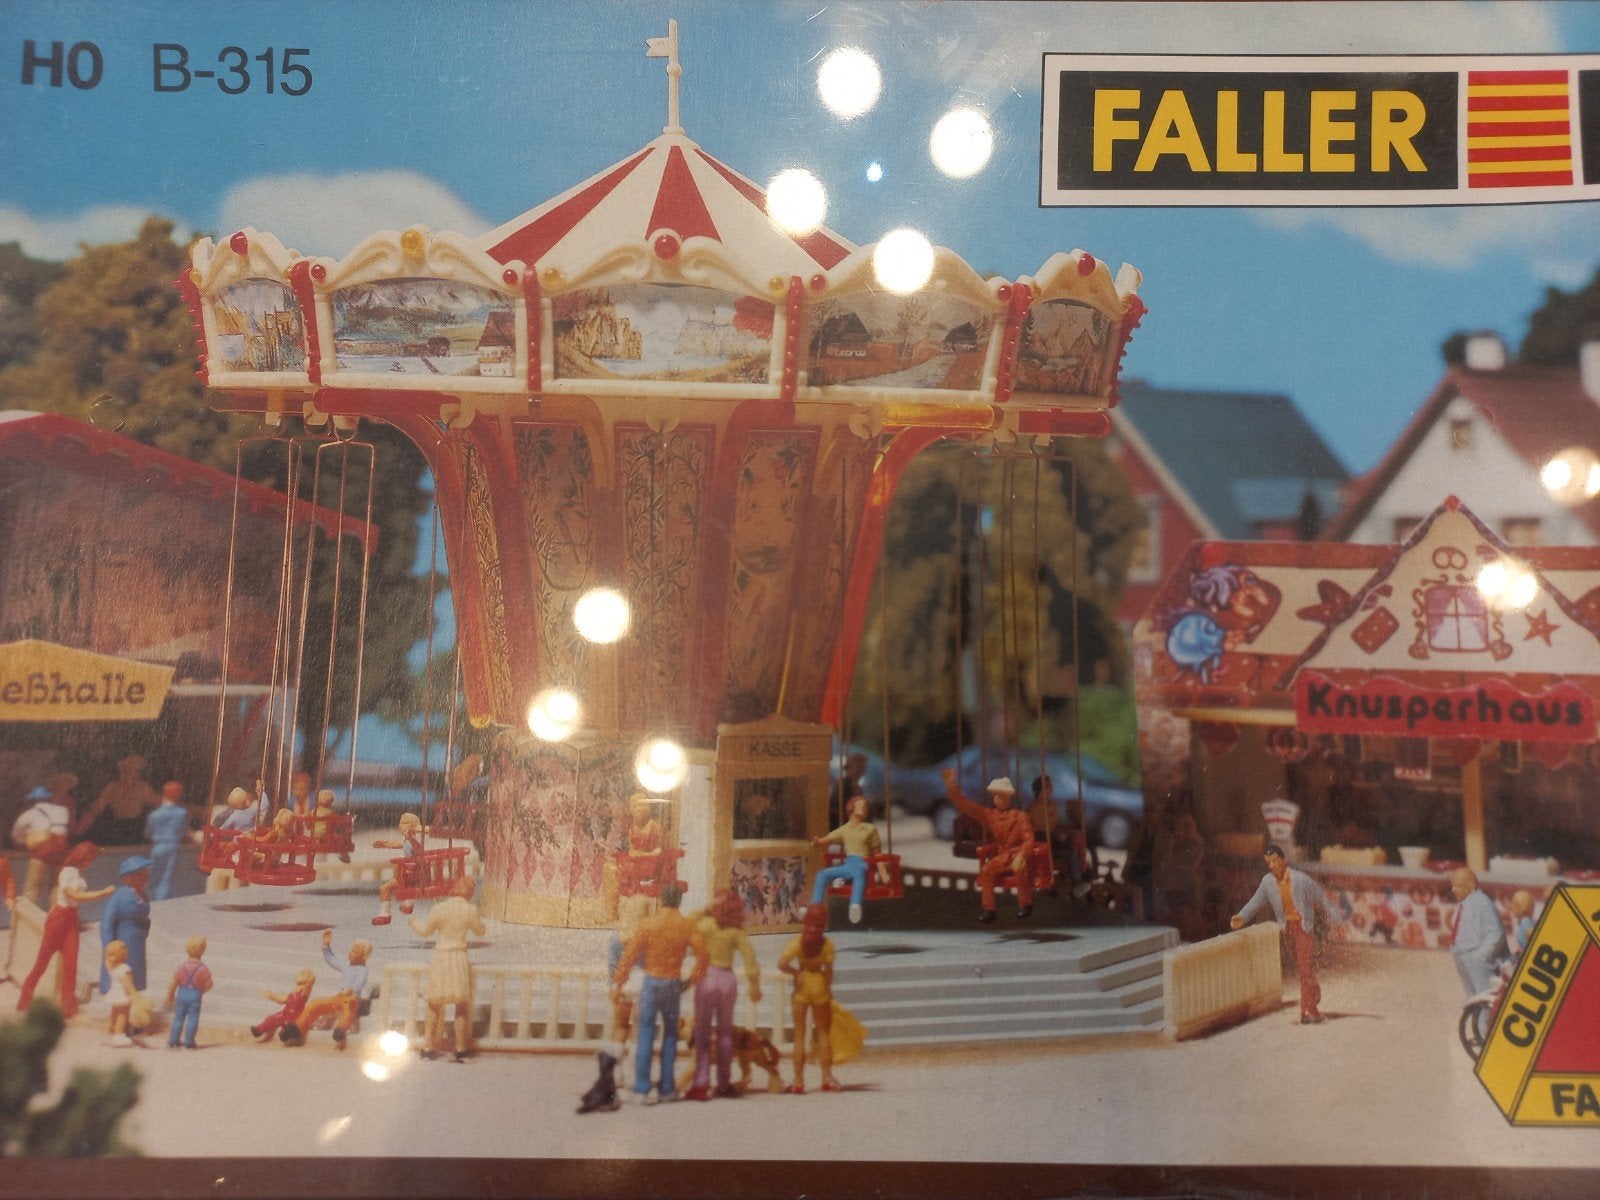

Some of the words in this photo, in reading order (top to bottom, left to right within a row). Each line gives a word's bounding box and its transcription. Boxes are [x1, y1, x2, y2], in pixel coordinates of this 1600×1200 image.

[153, 43, 313, 97] B-315
[1093, 90, 1428, 172] FALLER
[2, 672, 146, 705] eßhalle
[1309, 683, 1583, 729] Knusperhaus
[749, 741, 802, 757] KASSE
[1503, 944, 1568, 1048] CLUB
